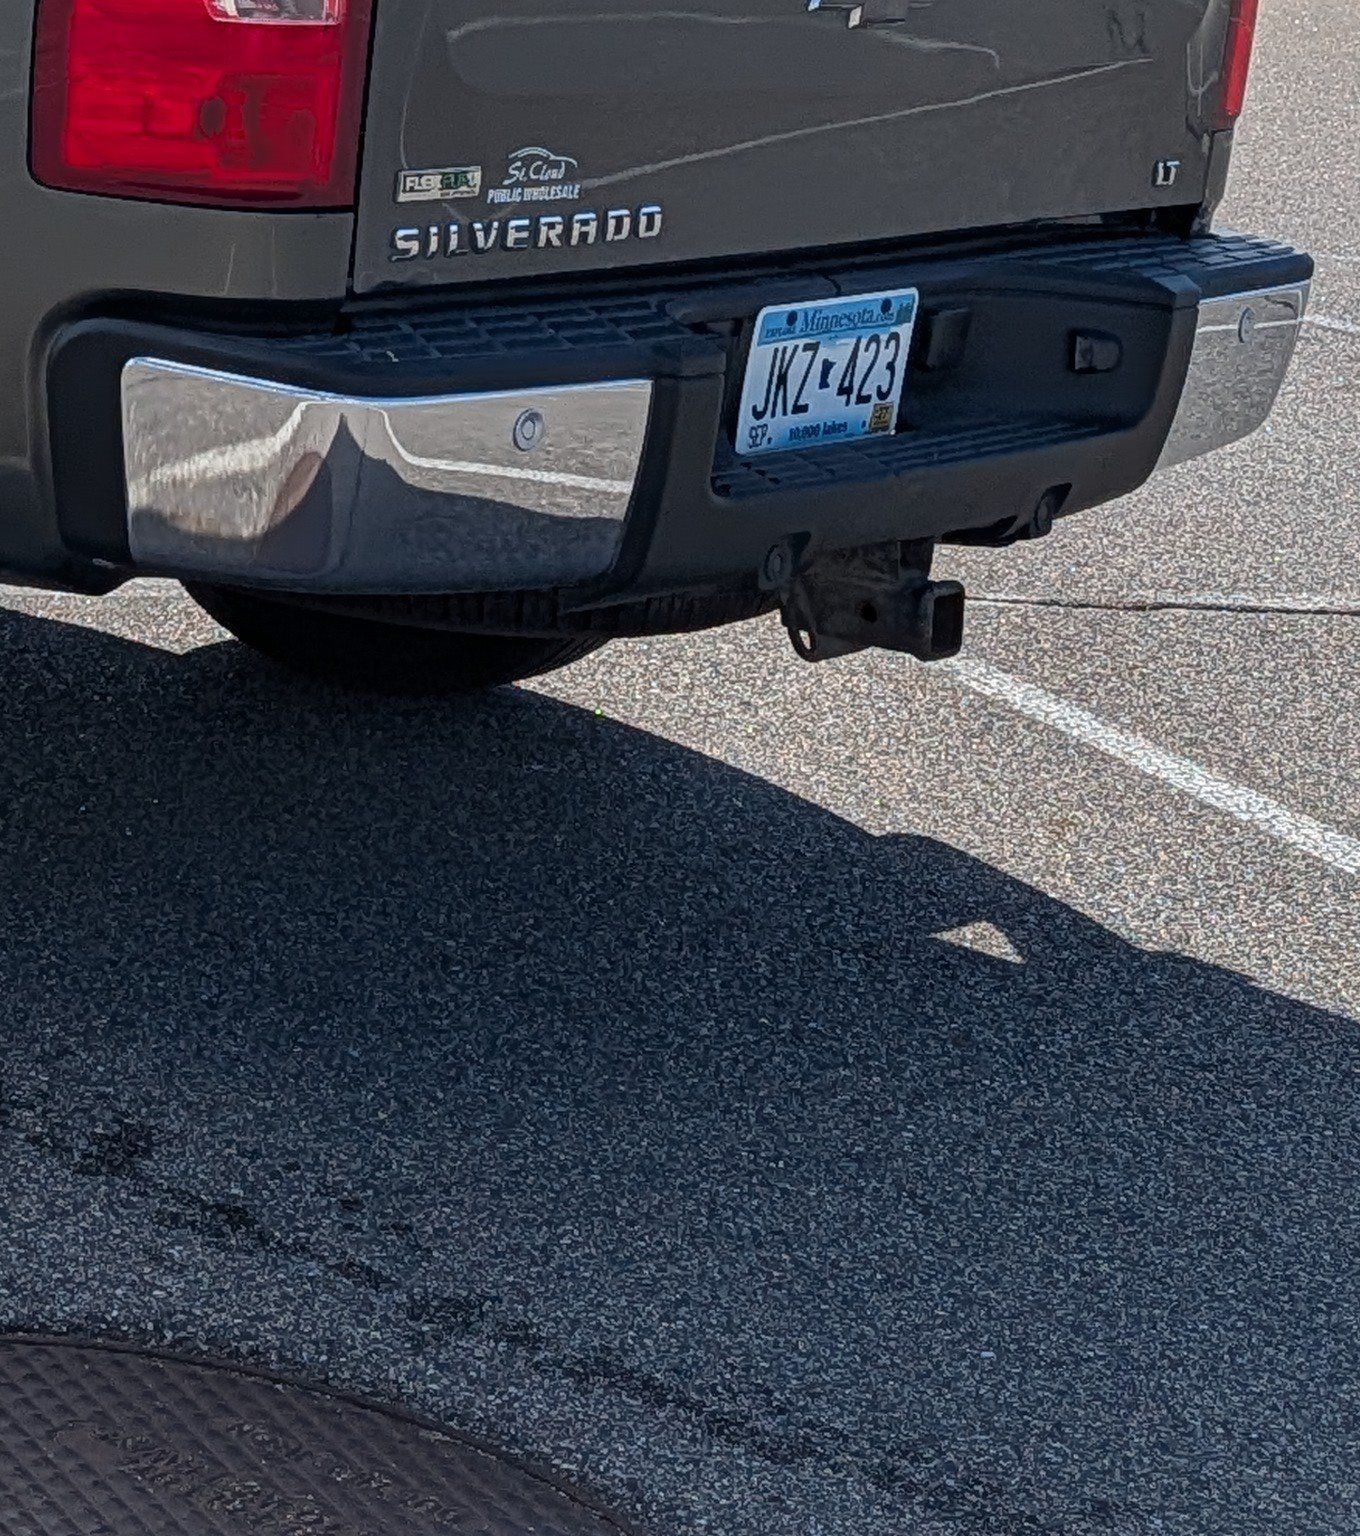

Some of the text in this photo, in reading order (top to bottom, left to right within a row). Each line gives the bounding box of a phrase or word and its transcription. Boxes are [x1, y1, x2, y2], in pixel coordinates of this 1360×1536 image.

[529, 161, 567, 181] Cloud
[1155, 159, 1182, 186] LT
[487, 188, 522, 204] PUBLIC
[523, 184, 581, 202] WHOLESALE
[391, 204, 664, 262] SILVERADO
[751, 331, 901, 422] JKZ 423
